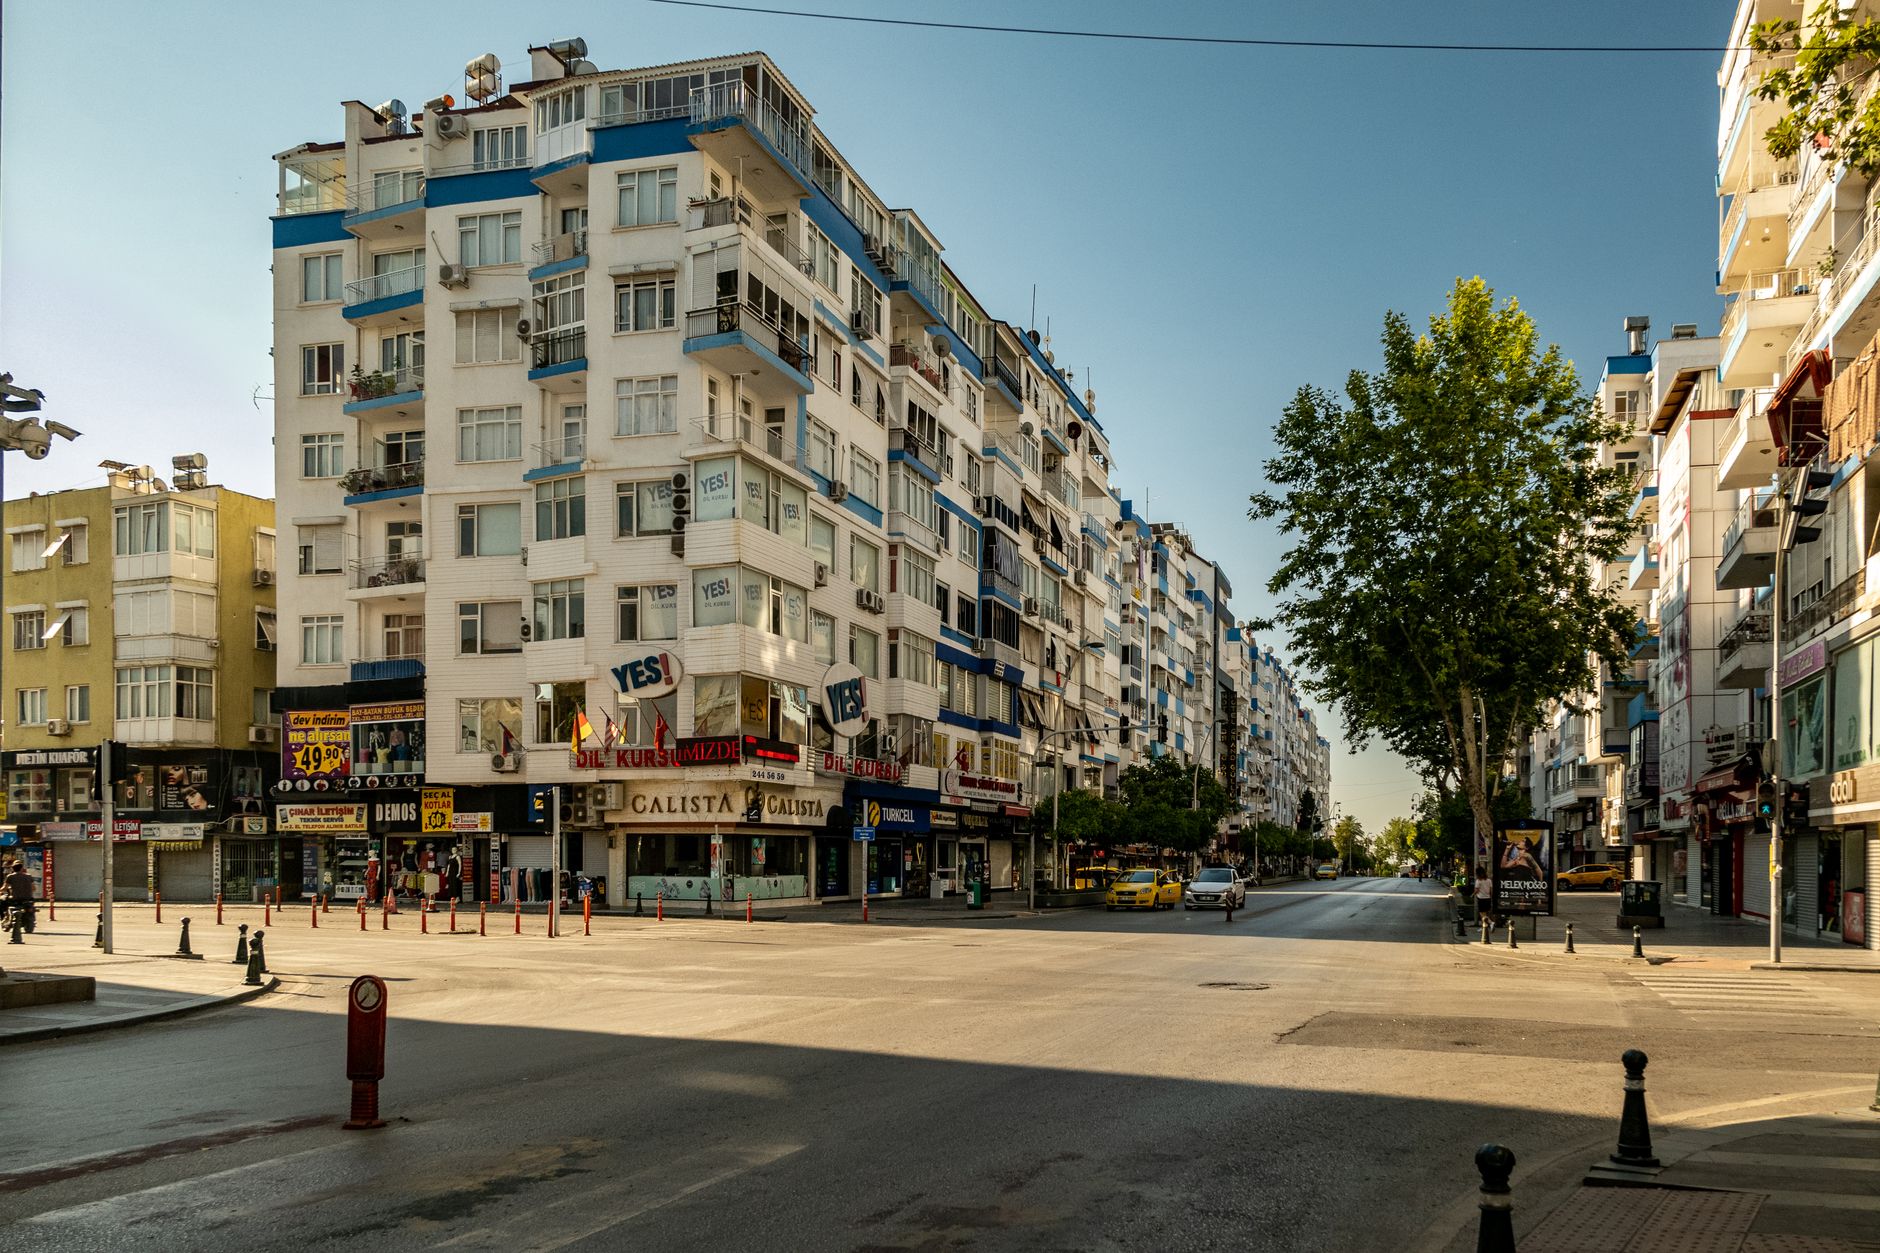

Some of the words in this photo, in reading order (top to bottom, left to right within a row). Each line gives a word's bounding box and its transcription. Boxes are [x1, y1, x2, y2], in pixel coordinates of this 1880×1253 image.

[647, 481, 673, 502] YES
[700, 471, 730, 495] YES!
[744, 481, 762, 500] YES!
[783, 503, 800, 520] YES!
[647, 584, 676, 601] YES
[702, 577, 731, 600] YES!
[744, 584, 762, 601] YES!
[611, 652, 673, 693] YES!
[826, 676, 869, 724] YES!
[293, 715, 309, 725] dev
[312, 713, 346, 725] indirim
[289, 731, 306, 743] ne
[752, 770, 765, 779] 244
[767, 771, 775, 780] 56
[776, 772, 785, 780] 59
[854, 758, 901, 780] KURSU
[424, 792, 439, 800] SEÇ
[632, 793, 733, 813] CALISTA
[289, 808, 315, 817] ÇINAR
[317, 806, 354, 816] İLETİŞİM
[376, 803, 416, 821] DEMOS
[424, 801, 452, 809] KOTLAR
[767, 793, 824, 817] CALISTA
[882, 807, 915, 823] TURKCELL
